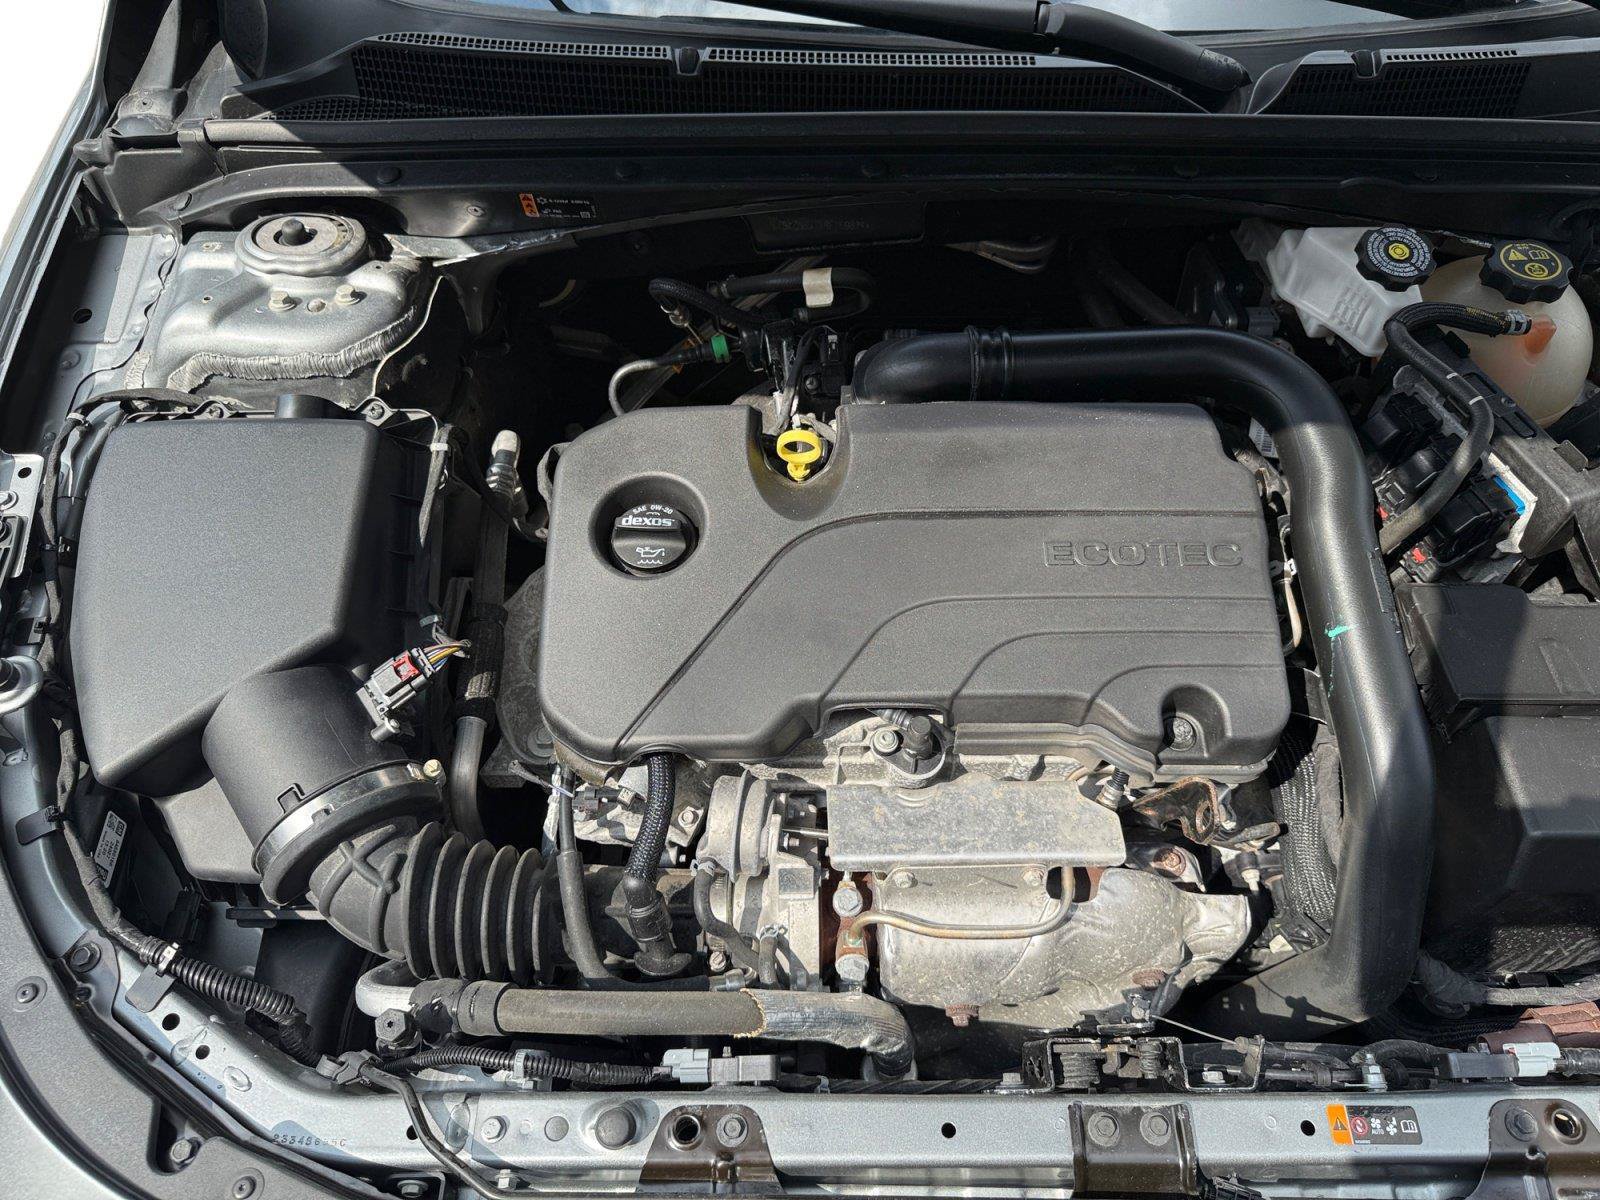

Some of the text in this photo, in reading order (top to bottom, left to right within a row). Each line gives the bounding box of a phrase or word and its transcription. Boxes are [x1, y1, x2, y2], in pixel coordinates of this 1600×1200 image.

[632, 504, 674, 515] SAE 0W-20
[621, 514, 673, 527] dexos
[1043, 541, 1243, 567] ECOTEC
